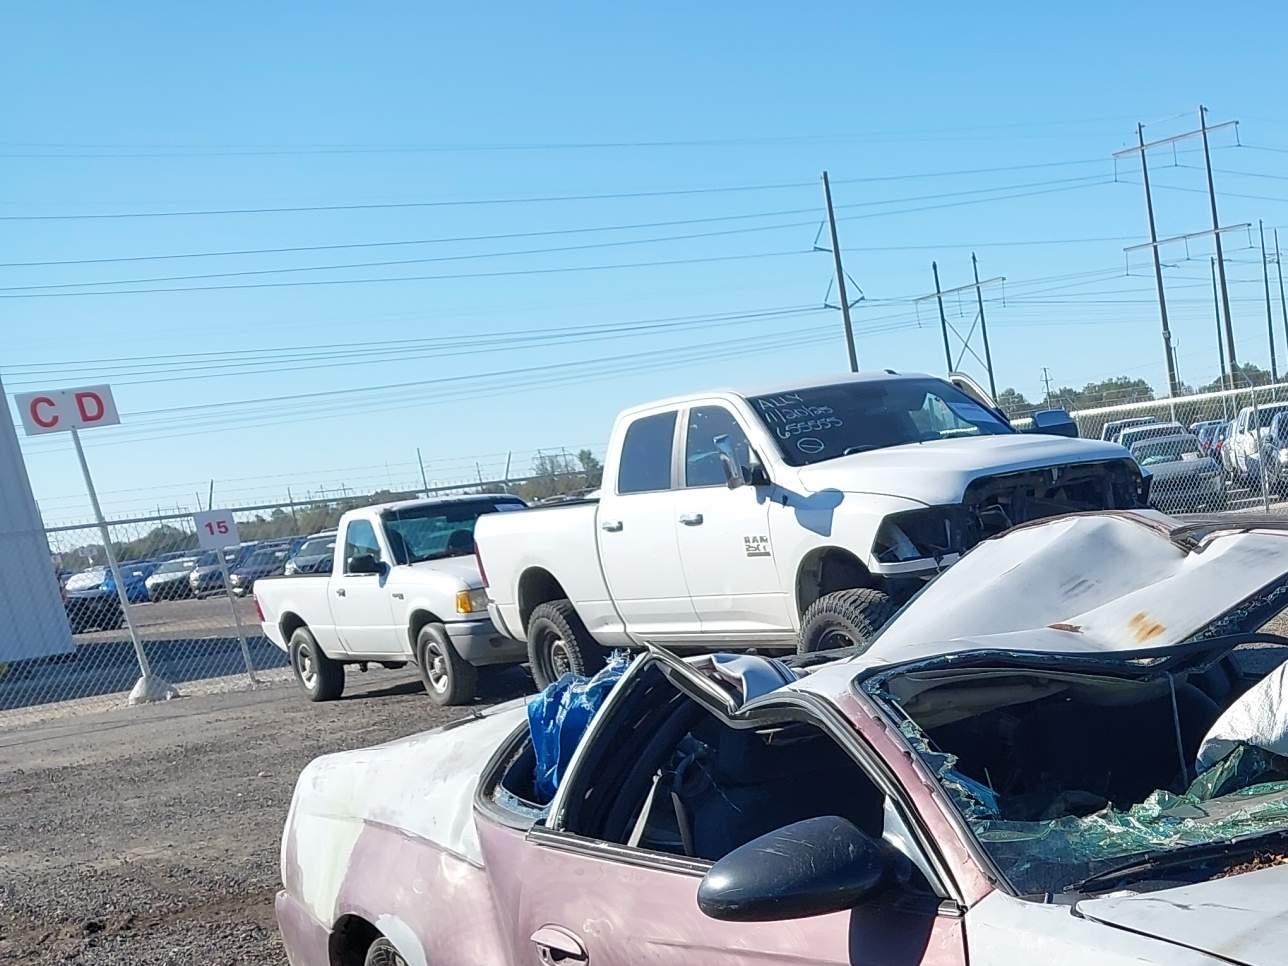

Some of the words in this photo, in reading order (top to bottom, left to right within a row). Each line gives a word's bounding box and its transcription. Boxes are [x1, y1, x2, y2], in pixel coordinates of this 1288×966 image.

[30, 396, 59, 428] C
[74, 391, 105, 422] D
[758, 393, 804, 410] ALLY
[204, 520, 229, 536] 15
